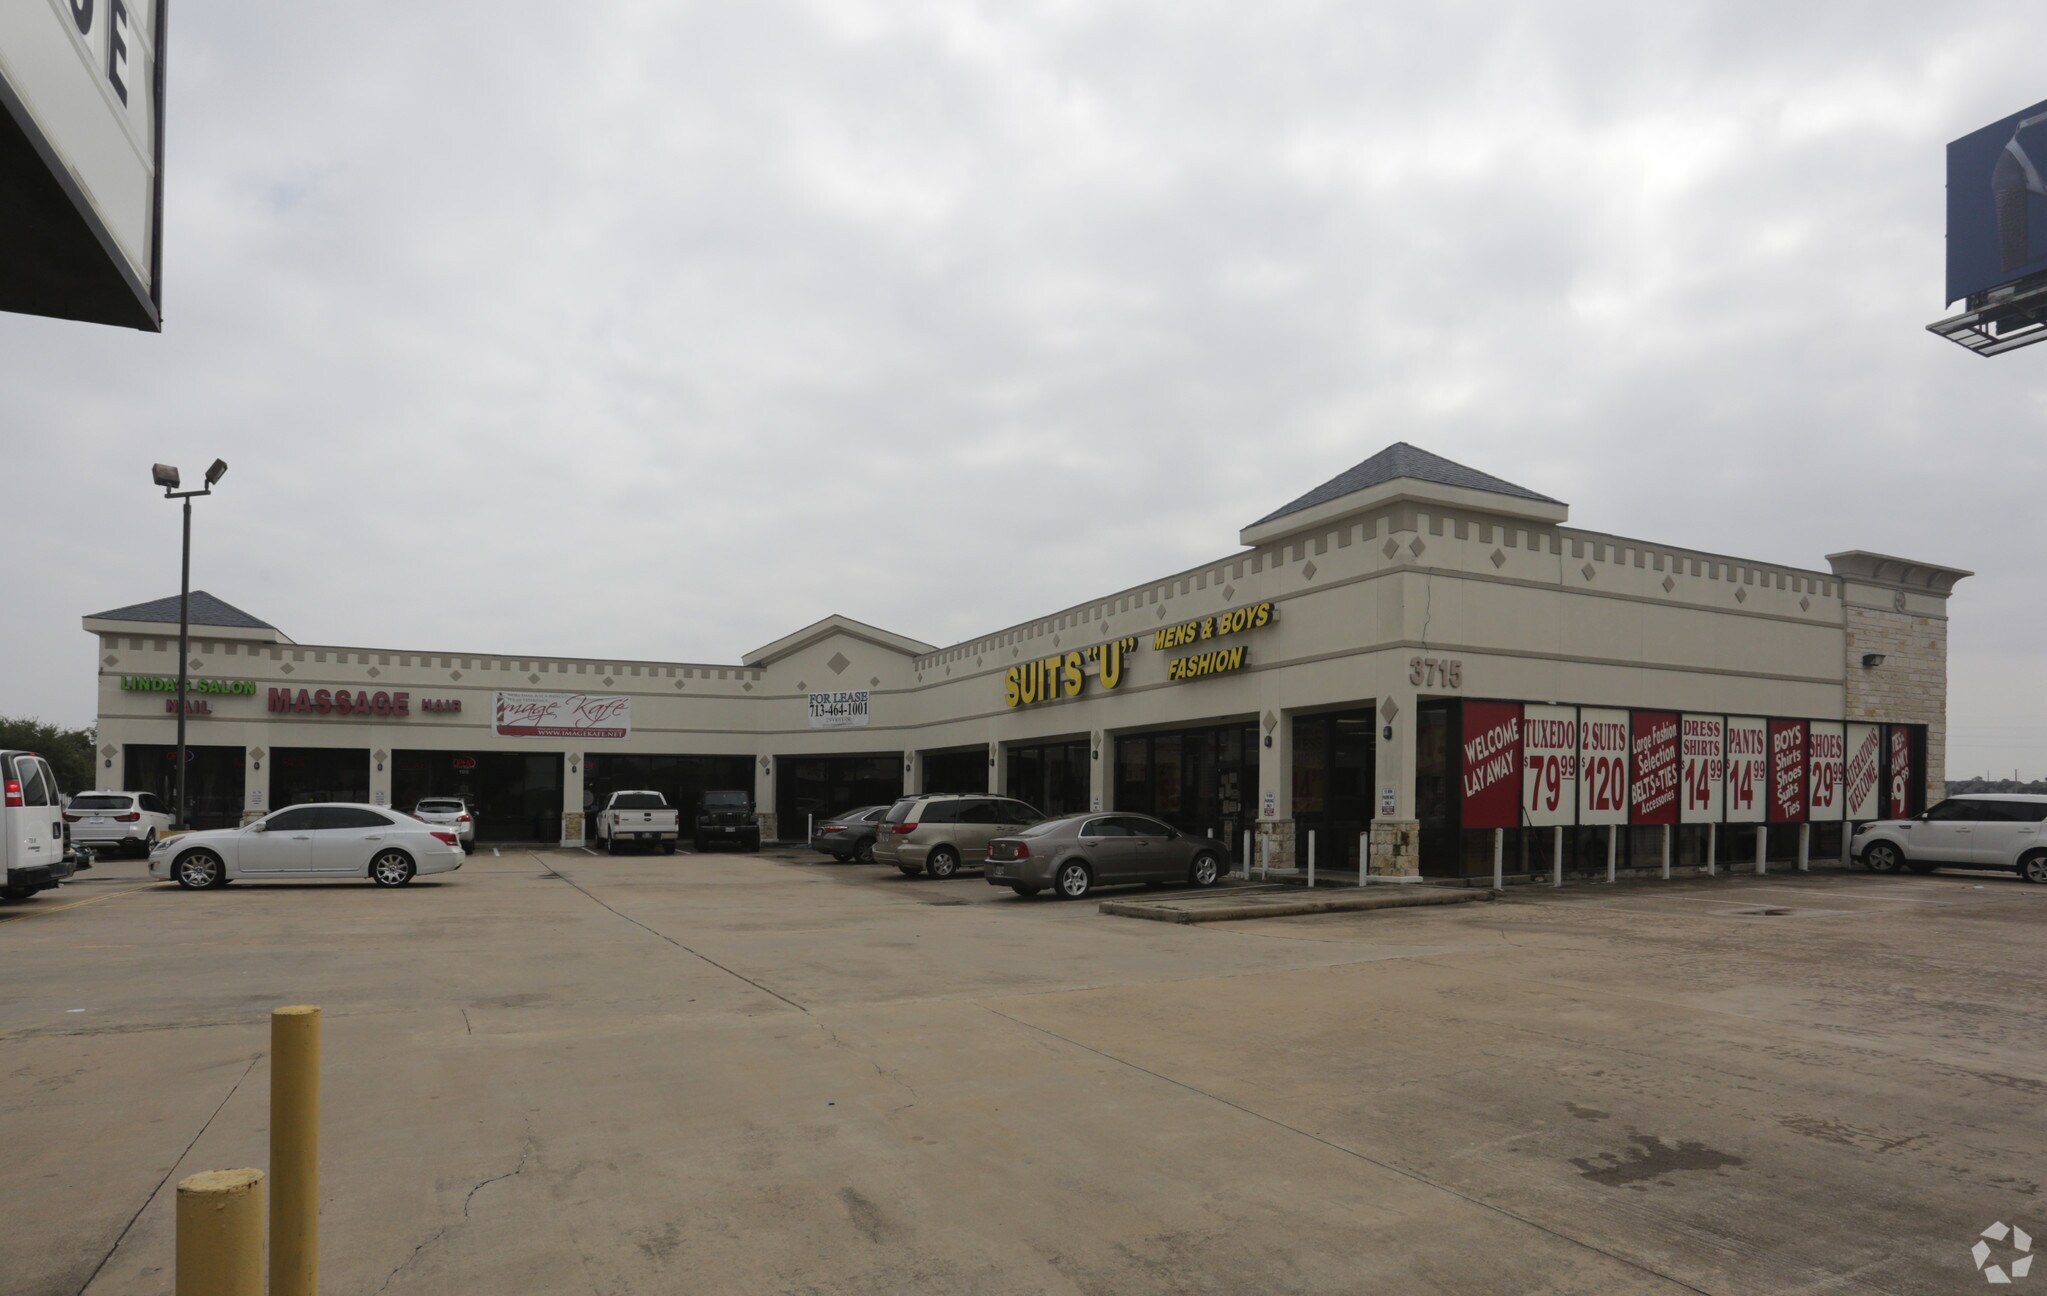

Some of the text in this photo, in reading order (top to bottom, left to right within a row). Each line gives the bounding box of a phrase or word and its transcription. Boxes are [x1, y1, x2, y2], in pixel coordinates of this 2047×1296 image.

[1153, 602, 1273, 651] MENS & BOYS
[1167, 646, 1246, 681] FASHION
[1409, 656, 1463, 689] 3715
[197, 678, 256, 695] SALON
[1004, 651, 1085, 708] SUITS
[268, 687, 410, 716] MASSAGE
[421, 698, 462, 713] HAIR
[809, 692, 868, 704] FOR LEASE
[810, 702, 868, 717] 713-464-1001
[1464, 717, 1519, 766] WELCOME
[1524, 719, 1575, 750] TUXEDO
[1582, 722, 1626, 751] 2 SUITS
[1632, 721, 1677, 755] Large Fashion
[1683, 720, 1720, 737] DRESS
[1728, 728, 1763, 754] PANTS
[1774, 725, 1801, 752] BOYS
[1683, 739, 1720, 757] SHIRTS
[1810, 733, 1842, 758] SHOES
[1638, 744, 1676, 776] Selection
[1775, 750, 1801, 771] Shirts
[1776, 766, 1802, 789] Shoes
[1849, 760, 1878, 815] WELCOME
[1642, 789, 1675, 815] Accessories
[1777, 782, 1799, 805] Suits
[1783, 801, 1800, 819] Ties
